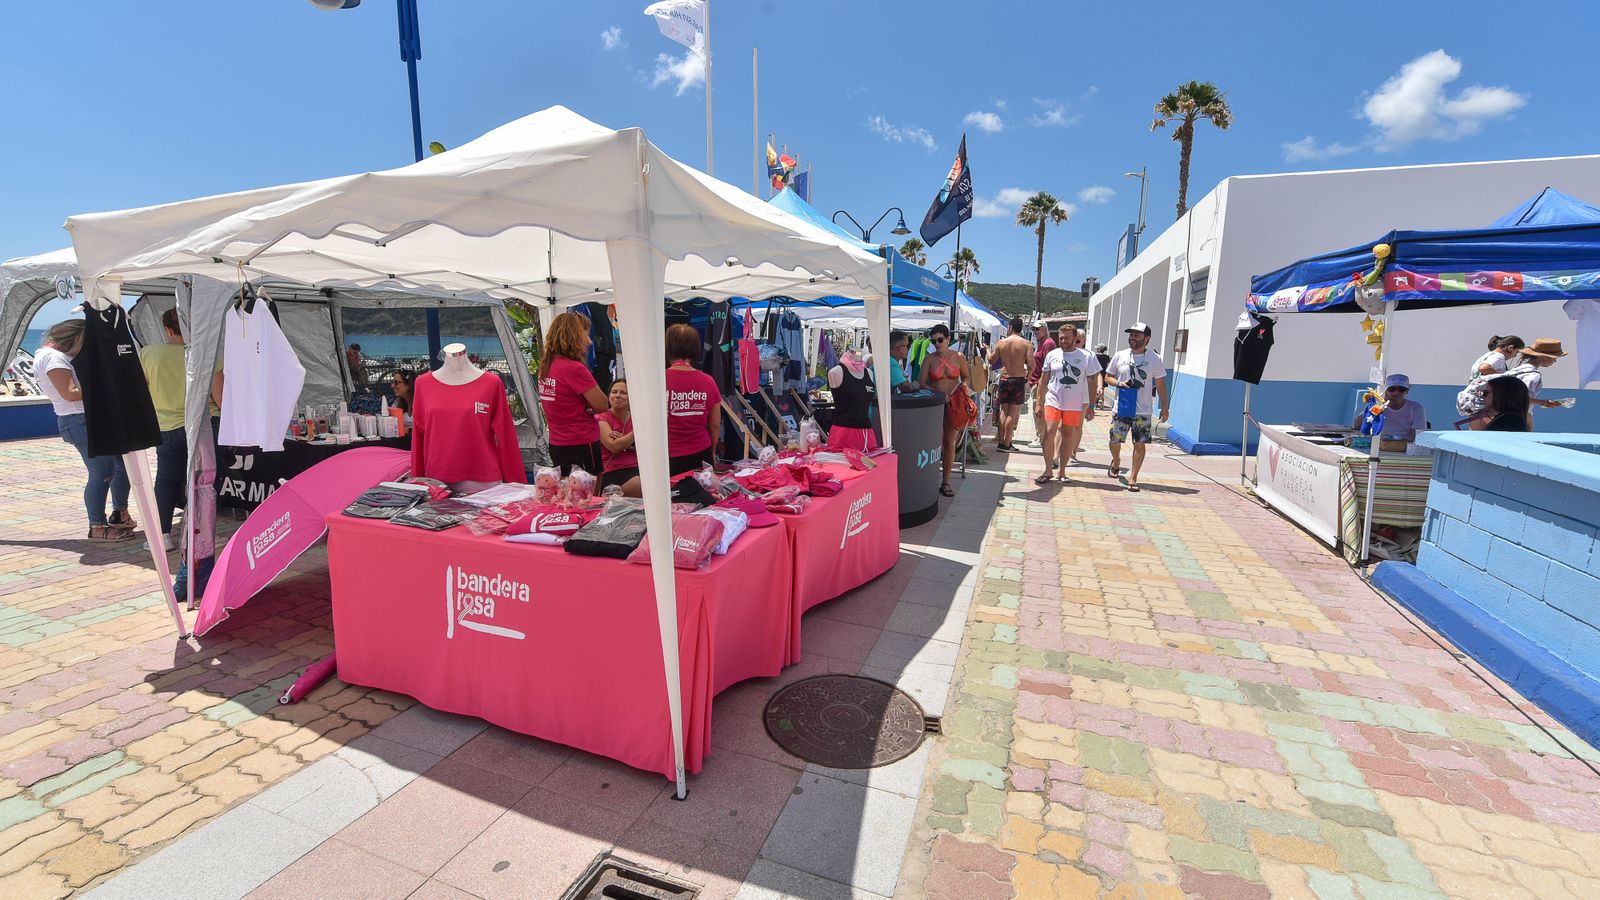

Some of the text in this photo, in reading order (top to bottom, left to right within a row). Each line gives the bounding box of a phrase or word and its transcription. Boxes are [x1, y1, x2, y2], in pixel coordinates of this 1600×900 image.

[670, 400, 690, 410] rosa
[671, 390, 707, 401] bandera
[852, 491, 872, 514] bandera
[252, 511, 290, 546] bandera
[253, 532, 275, 554] rosa
[457, 566, 530, 602] bandera
[457, 591, 495, 619] rosa
